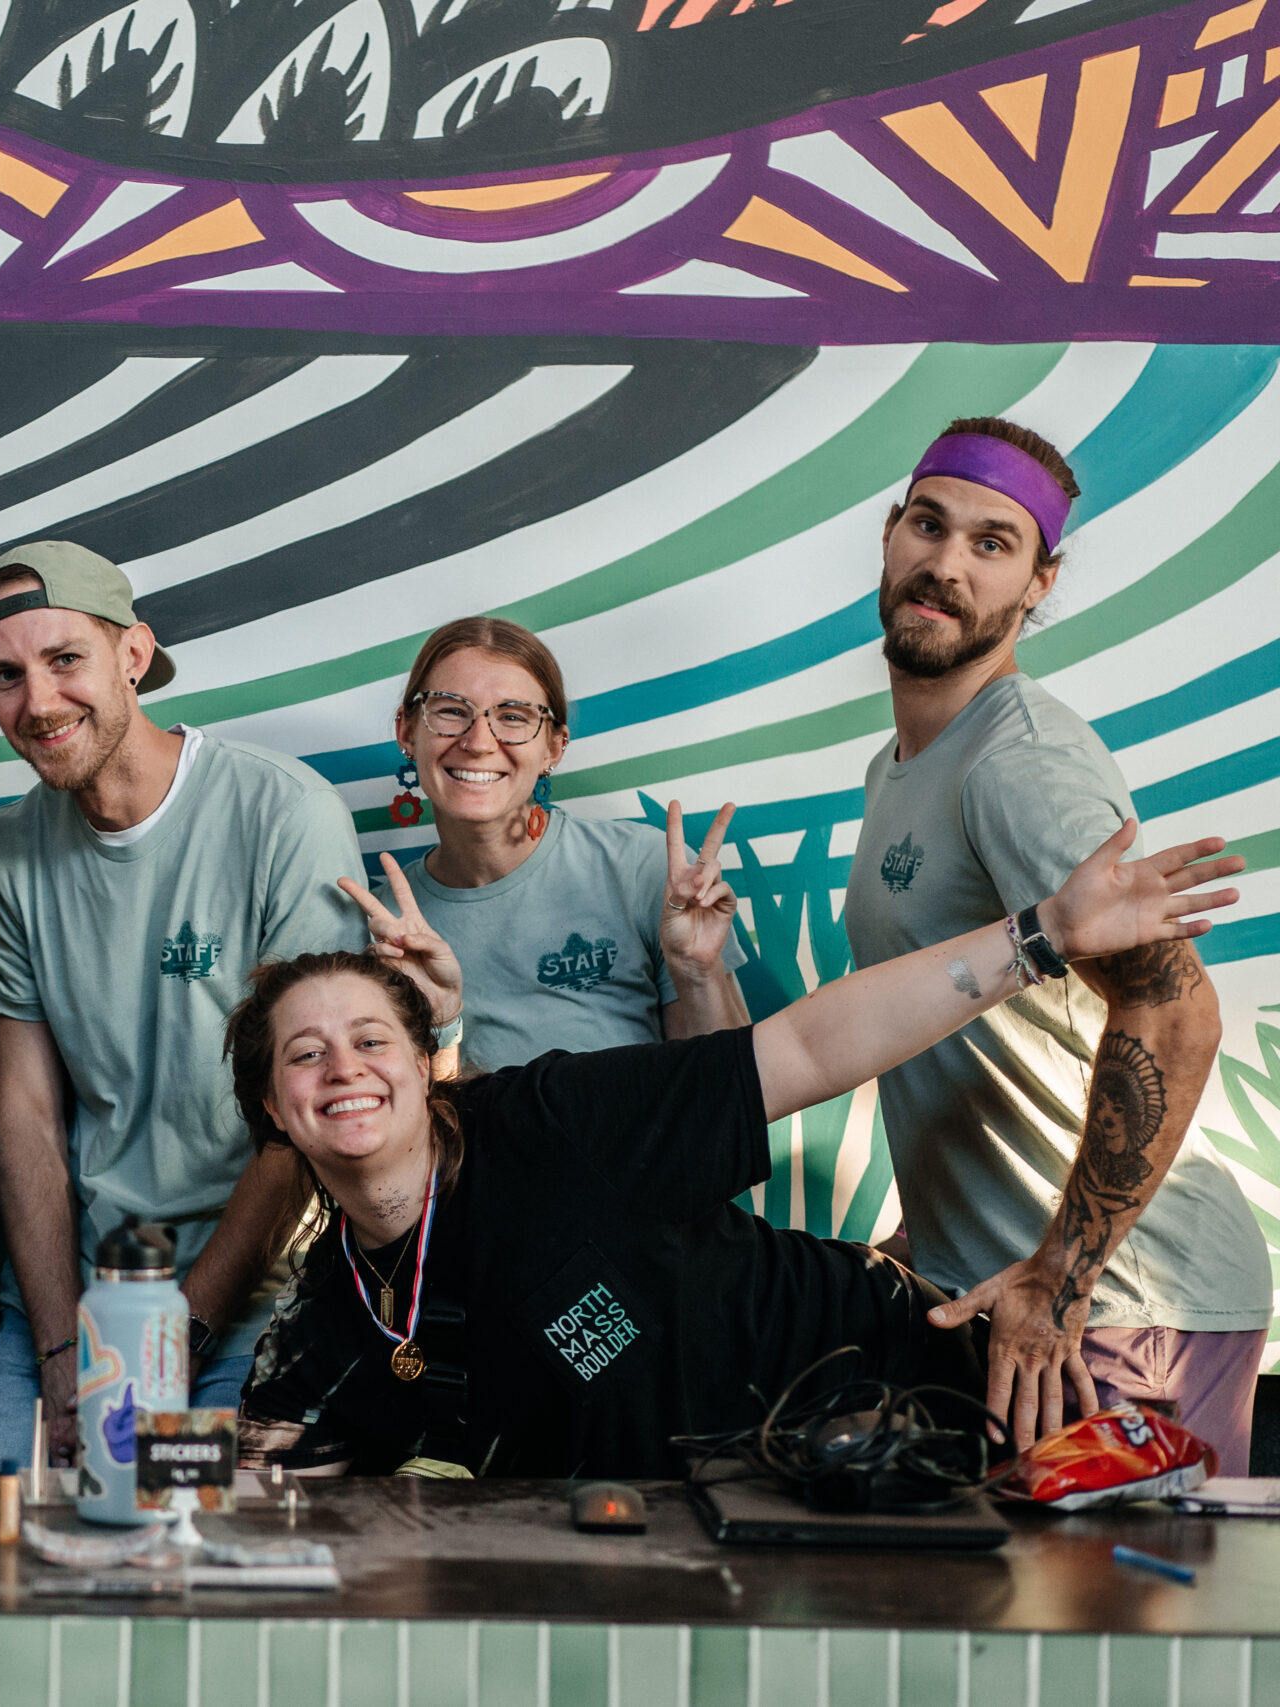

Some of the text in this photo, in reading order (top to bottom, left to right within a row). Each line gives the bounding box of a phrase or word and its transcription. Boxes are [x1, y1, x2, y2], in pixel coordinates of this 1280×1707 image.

[884, 850, 924, 877] STAFF
[161, 943, 222, 963] STAFF
[543, 947, 618, 976] STAFF
[543, 1282, 613, 1347] NORTH
[559, 1302, 625, 1364] MASS
[574, 1318, 641, 1382] BOULDER
[150, 1443, 222, 1463] STICKERS
